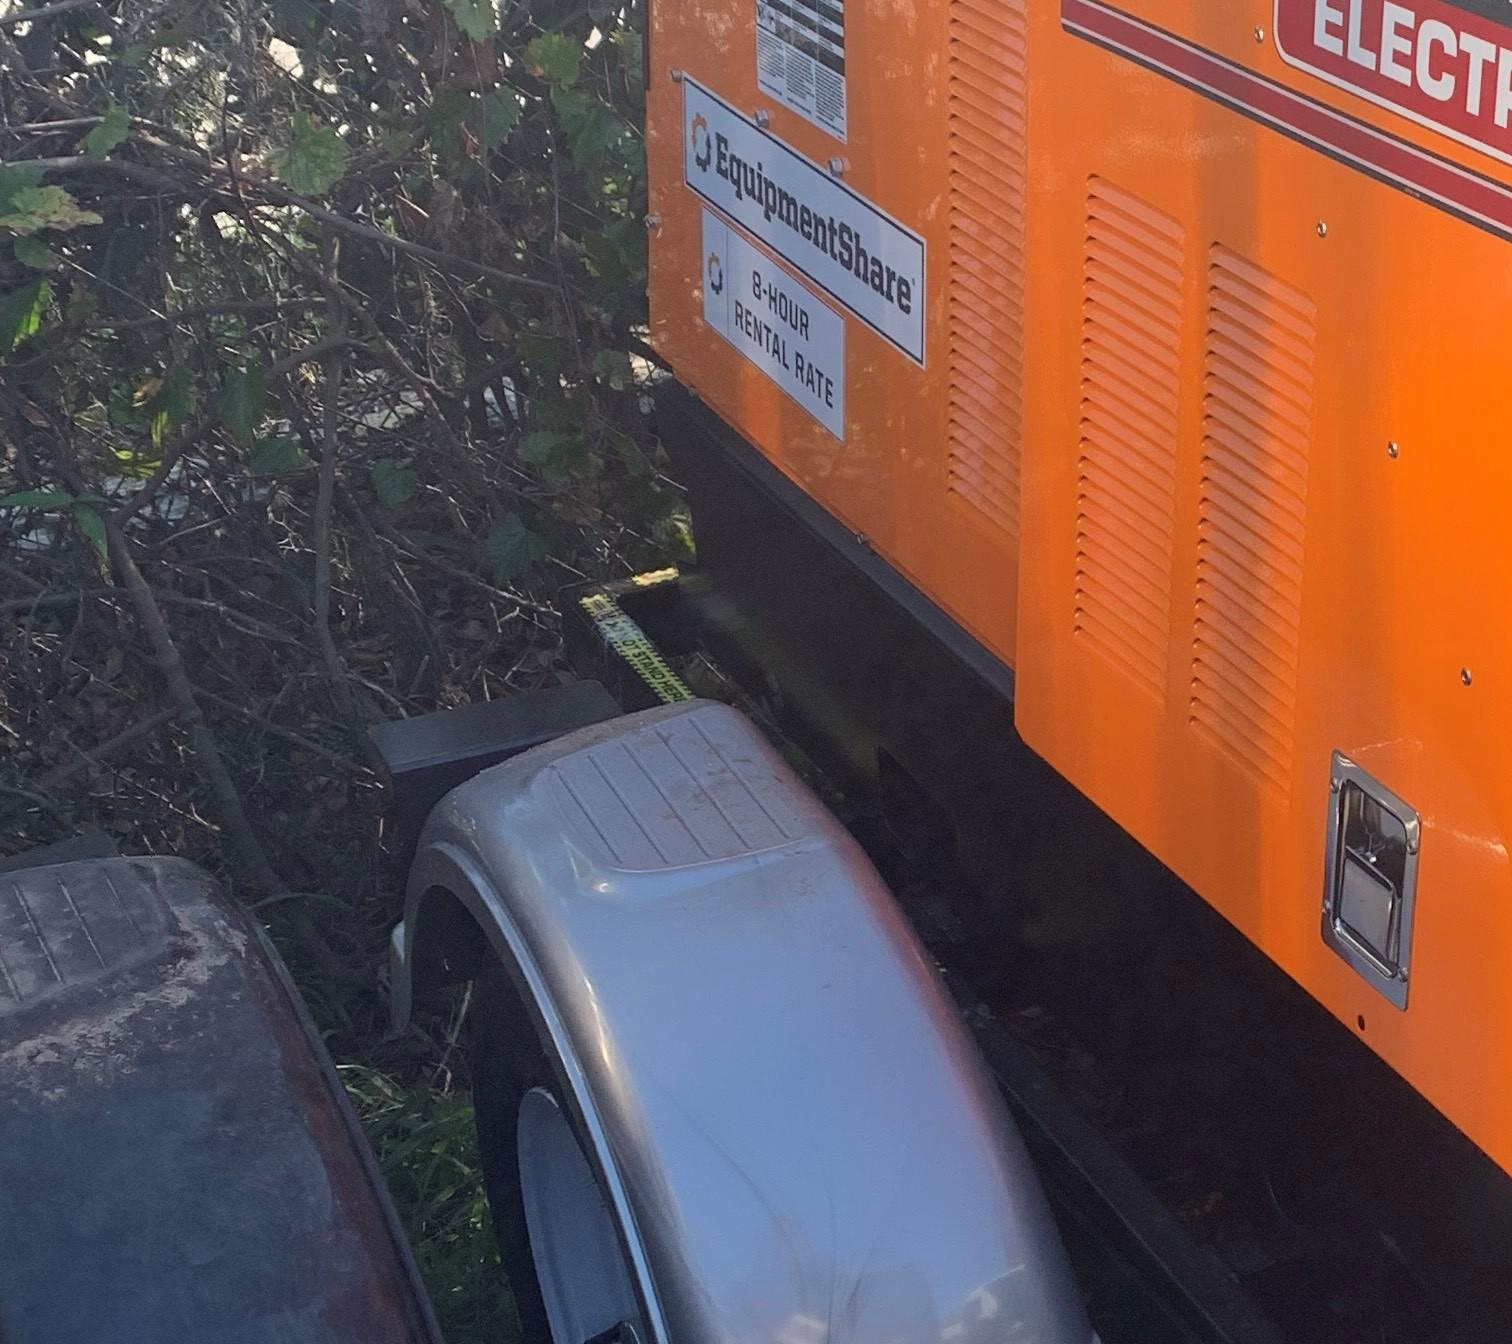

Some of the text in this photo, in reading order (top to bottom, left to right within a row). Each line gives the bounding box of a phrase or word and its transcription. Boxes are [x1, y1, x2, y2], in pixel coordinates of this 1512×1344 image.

[714, 131, 913, 316] EquipmentShare
[734, 301, 834, 409] RENTAL RATE
[752, 269, 810, 342] 8-HOUR
